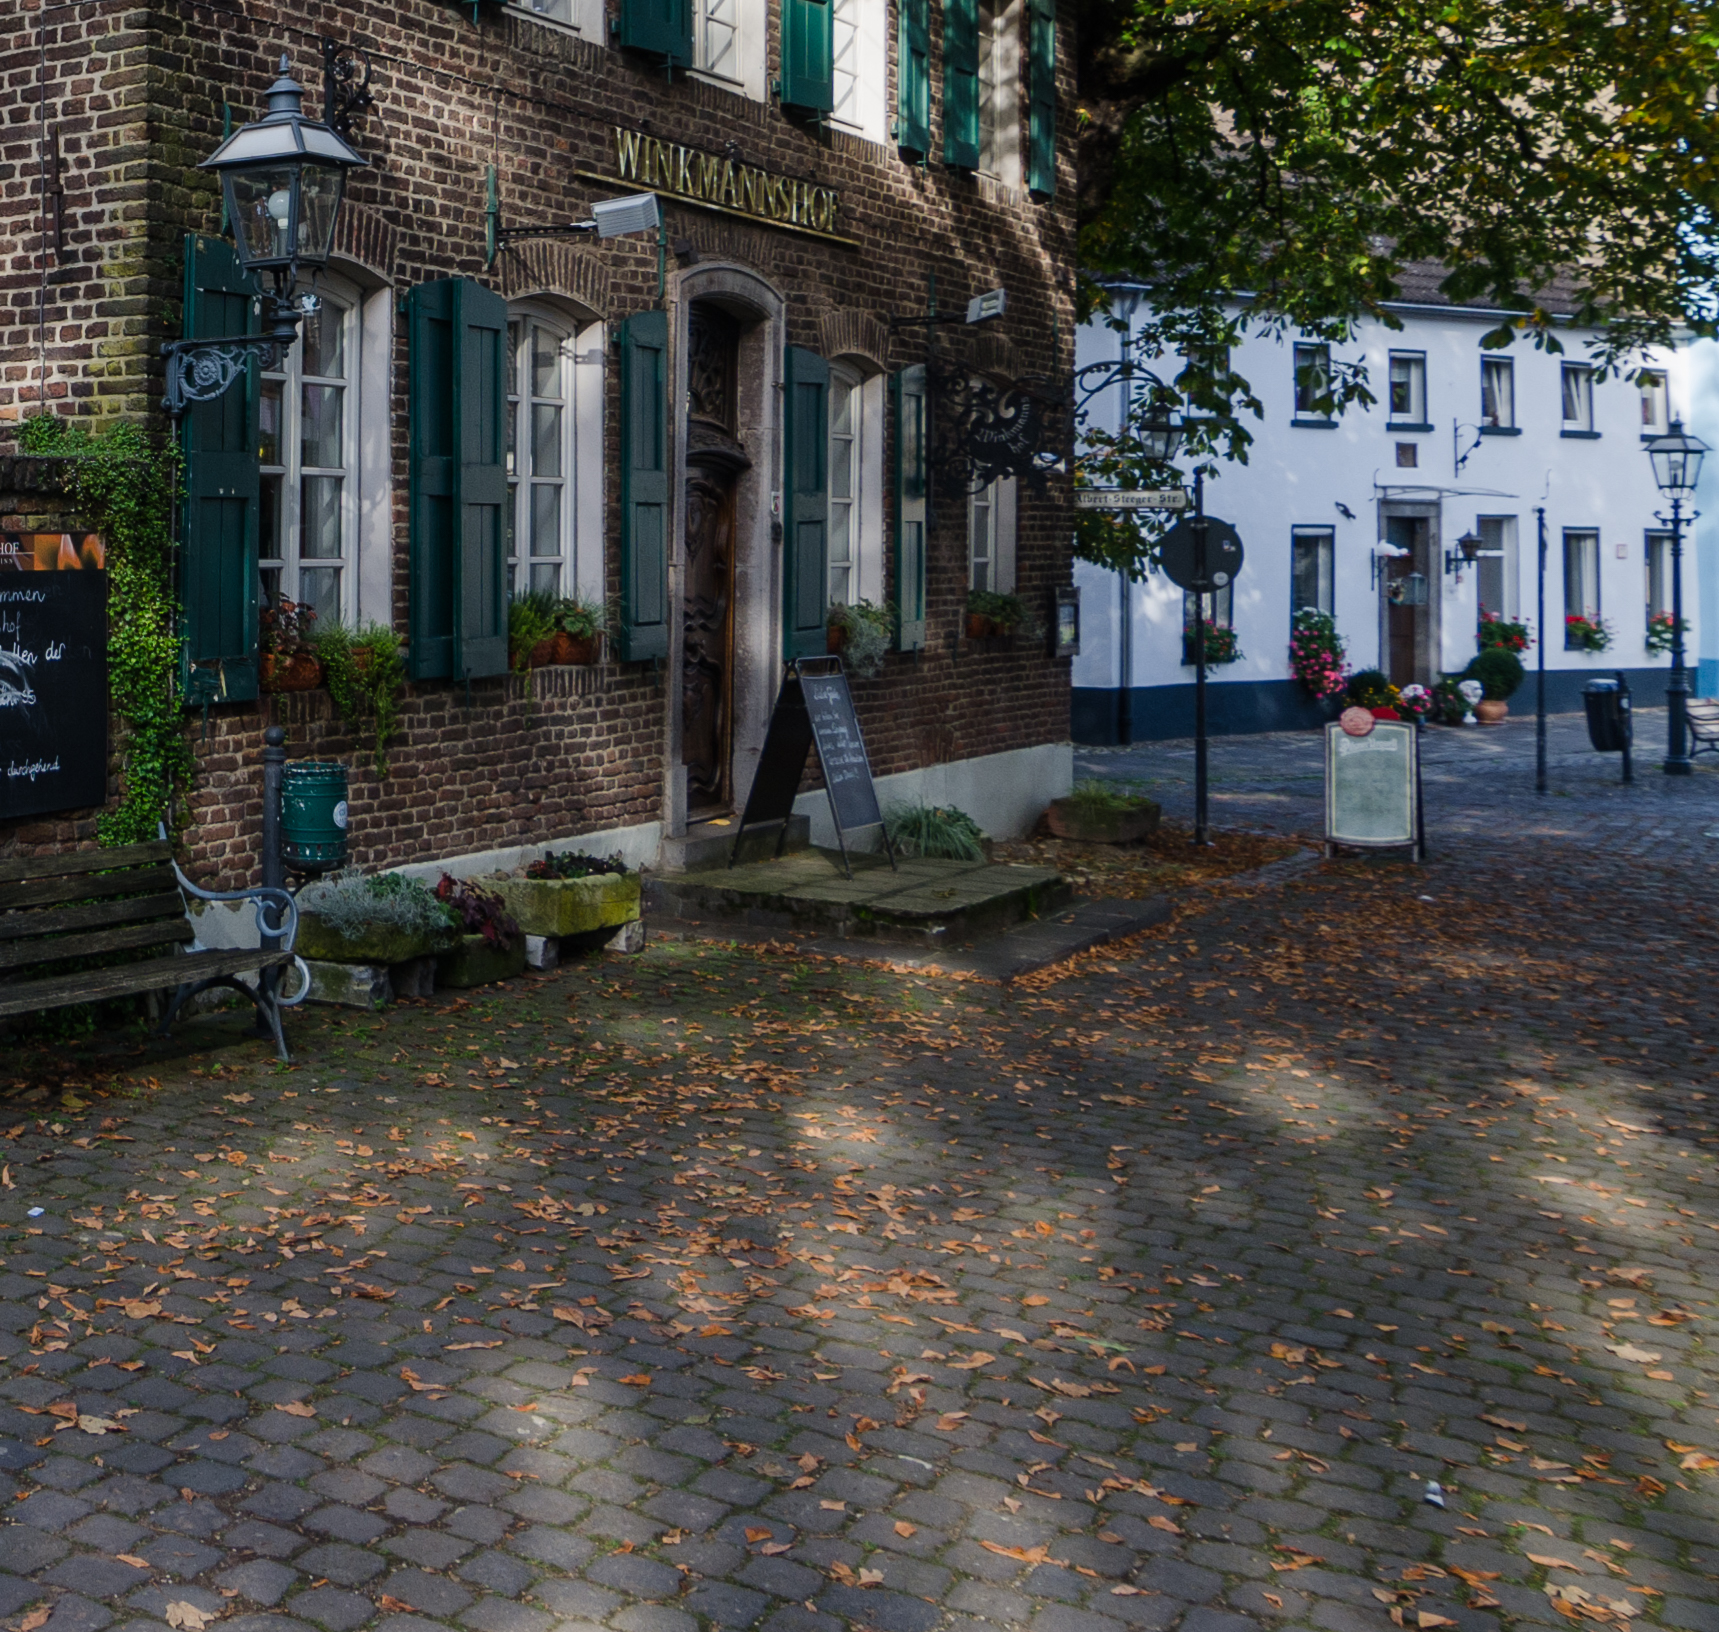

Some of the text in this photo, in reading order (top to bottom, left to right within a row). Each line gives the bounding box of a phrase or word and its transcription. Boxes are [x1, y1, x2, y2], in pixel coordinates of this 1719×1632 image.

[612, 125, 839, 234] WINKMANNSHOF
[45, 640, 66, 661] der
[7, 755, 61, 782] durchgehend
